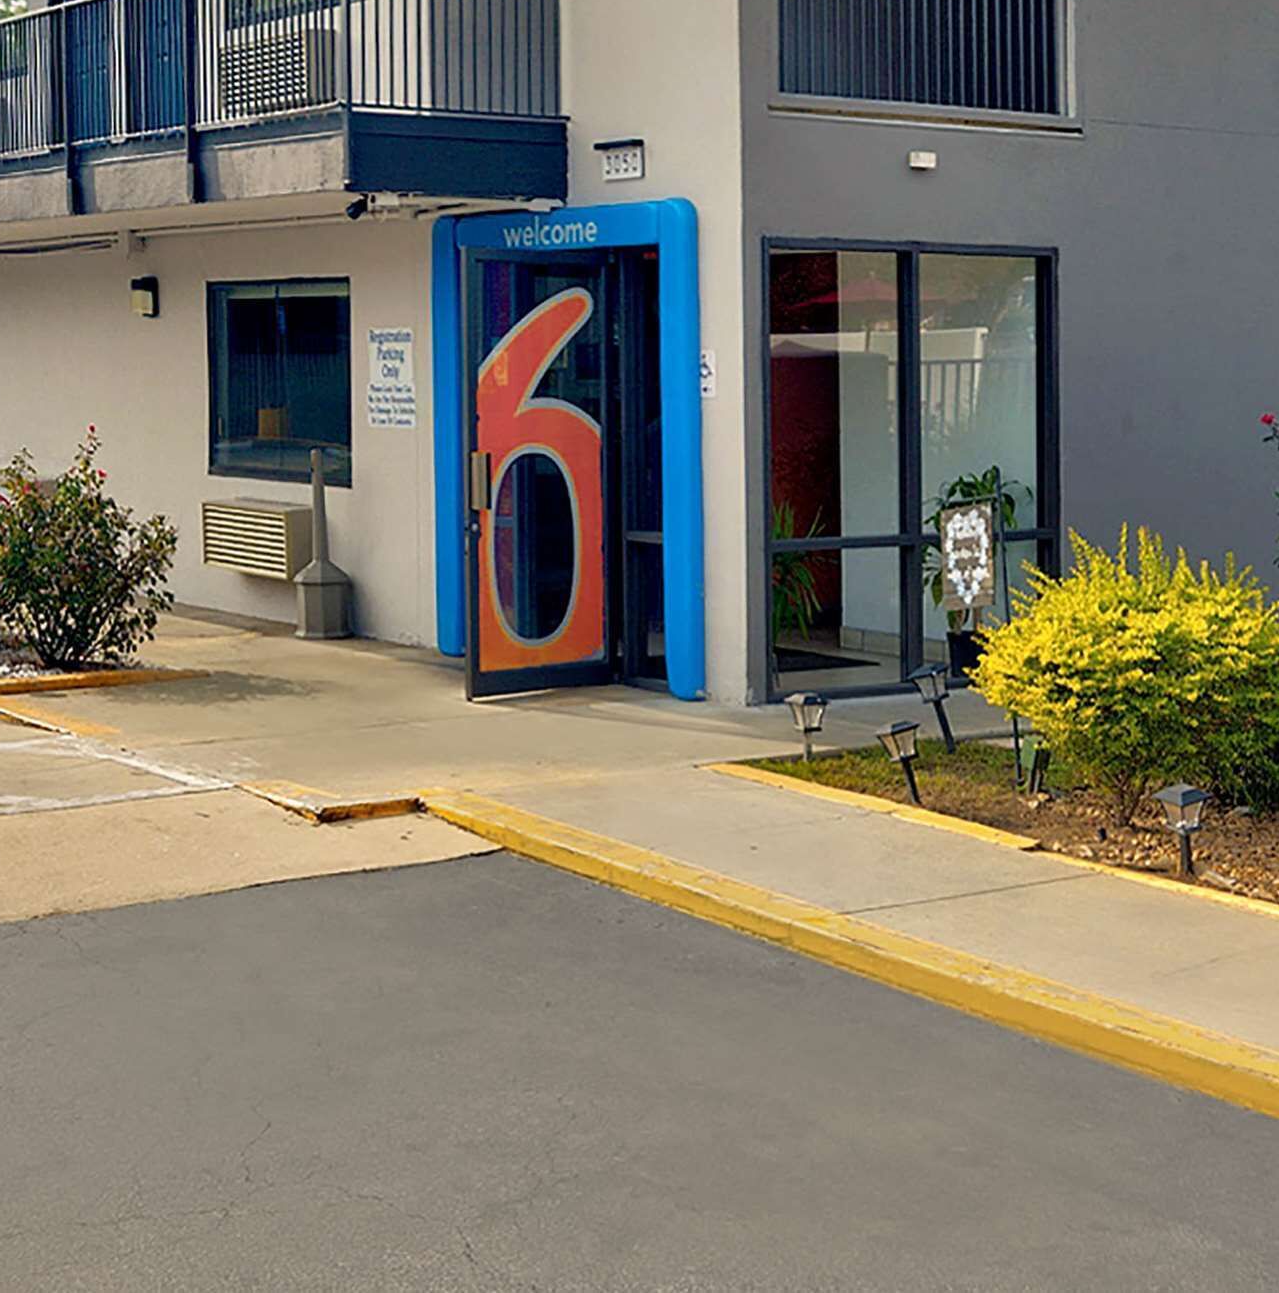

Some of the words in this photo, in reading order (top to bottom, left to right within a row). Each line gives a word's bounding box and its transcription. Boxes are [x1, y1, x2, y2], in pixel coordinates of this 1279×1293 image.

[503, 215, 598, 248] welcome
[376, 346, 405, 365] Parking
[381, 363, 400, 381] Only
[477, 287, 605, 673] 6
